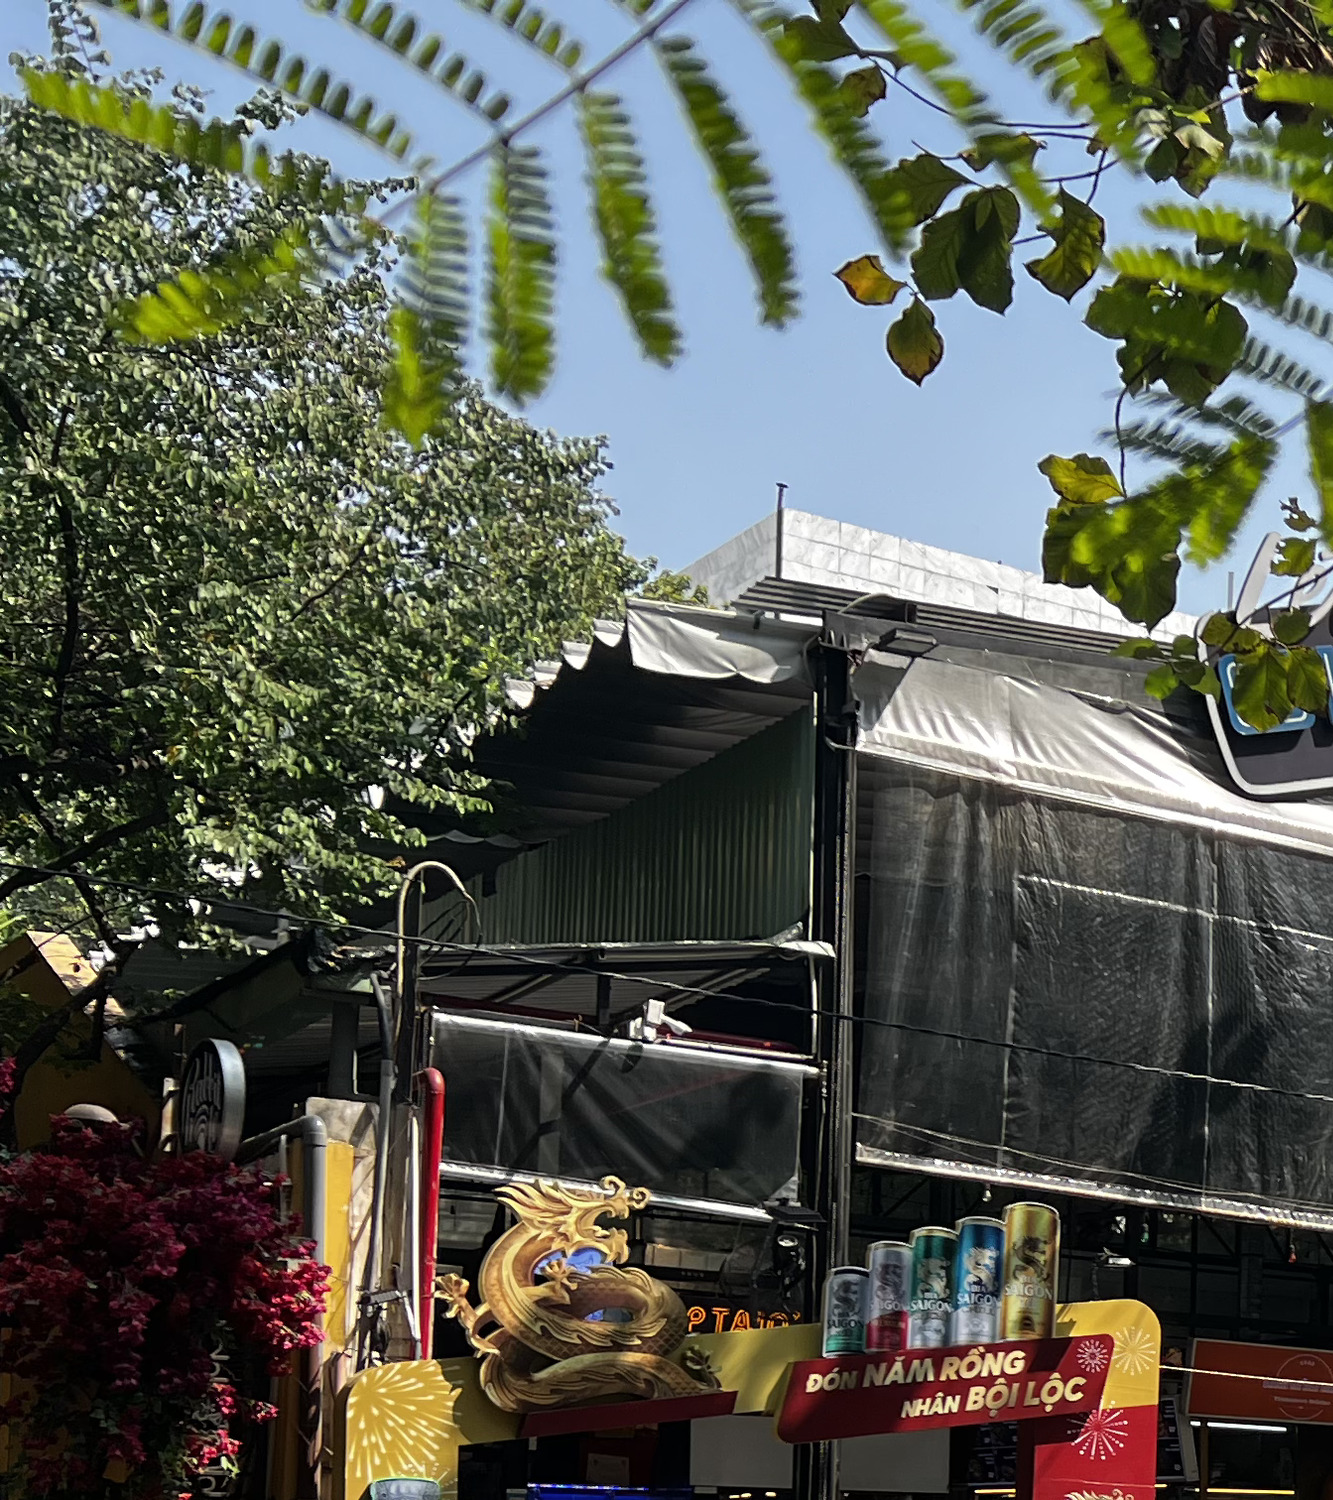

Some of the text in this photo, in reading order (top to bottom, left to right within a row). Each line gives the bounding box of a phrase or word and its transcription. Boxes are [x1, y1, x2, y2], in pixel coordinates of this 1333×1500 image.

[1005, 1282, 1052, 1300] SAIGON
[911, 1300, 952, 1312] SAIGON
[806, 1367, 857, 1393] ĐÓN
[862, 1356, 935, 1387] NĂM
[901, 1372, 1087, 1418] NHÂN BỘI LỘC
